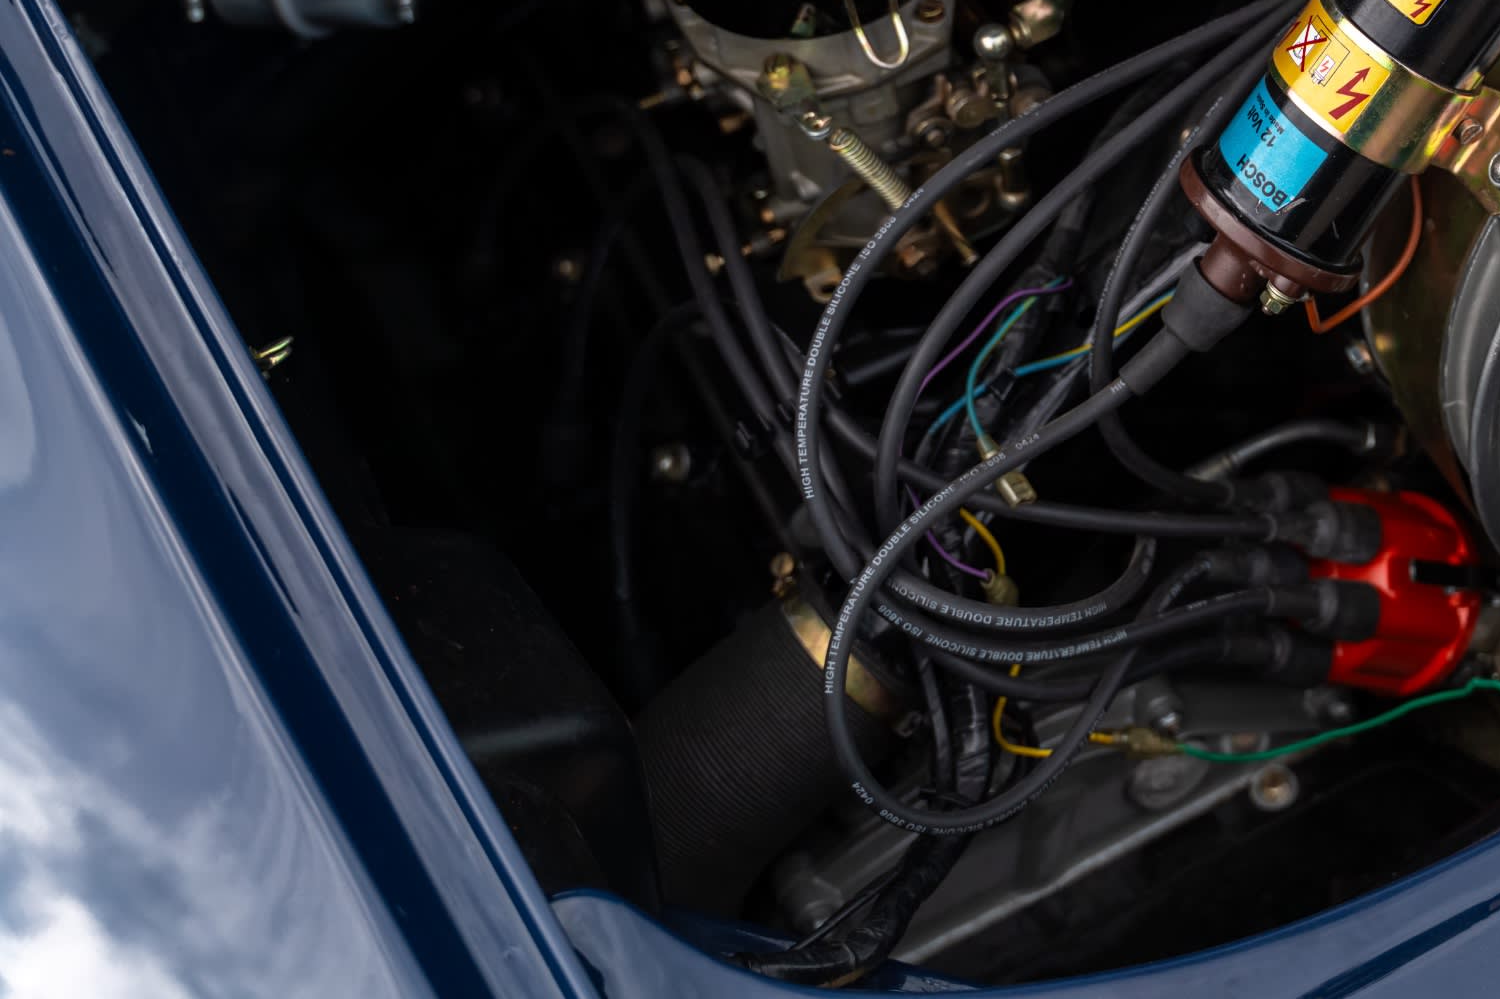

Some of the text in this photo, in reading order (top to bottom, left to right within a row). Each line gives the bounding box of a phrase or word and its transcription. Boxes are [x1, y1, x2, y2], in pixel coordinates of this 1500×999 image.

[1247, 105, 1276, 148] 12 Volt
[1236, 153, 1288, 207] BOSCH
[858, 240, 876, 260] ISO
[827, 263, 861, 316] SILICONE
[807, 318, 831, 367] DOUBLE
[797, 368, 814, 464] TEMPERATURE
[800, 465, 816, 500] HIGH
[909, 483, 956, 525] SILICONE
[872, 525, 911, 567] DOUBLE
[830, 566, 876, 660] TEMPERATURE
[903, 622, 924, 637] ISO
[940, 604, 993, 625] DOUBLE
[995, 609, 1084, 628] TEMPERATURE
[925, 633, 977, 657] SILICONE
[979, 647, 1024, 662] DOUBLE
[1026, 639, 1102, 662] TEMPERATURE
[824, 660, 837, 694] HIGH
[851, 781, 875, 805] 0424
